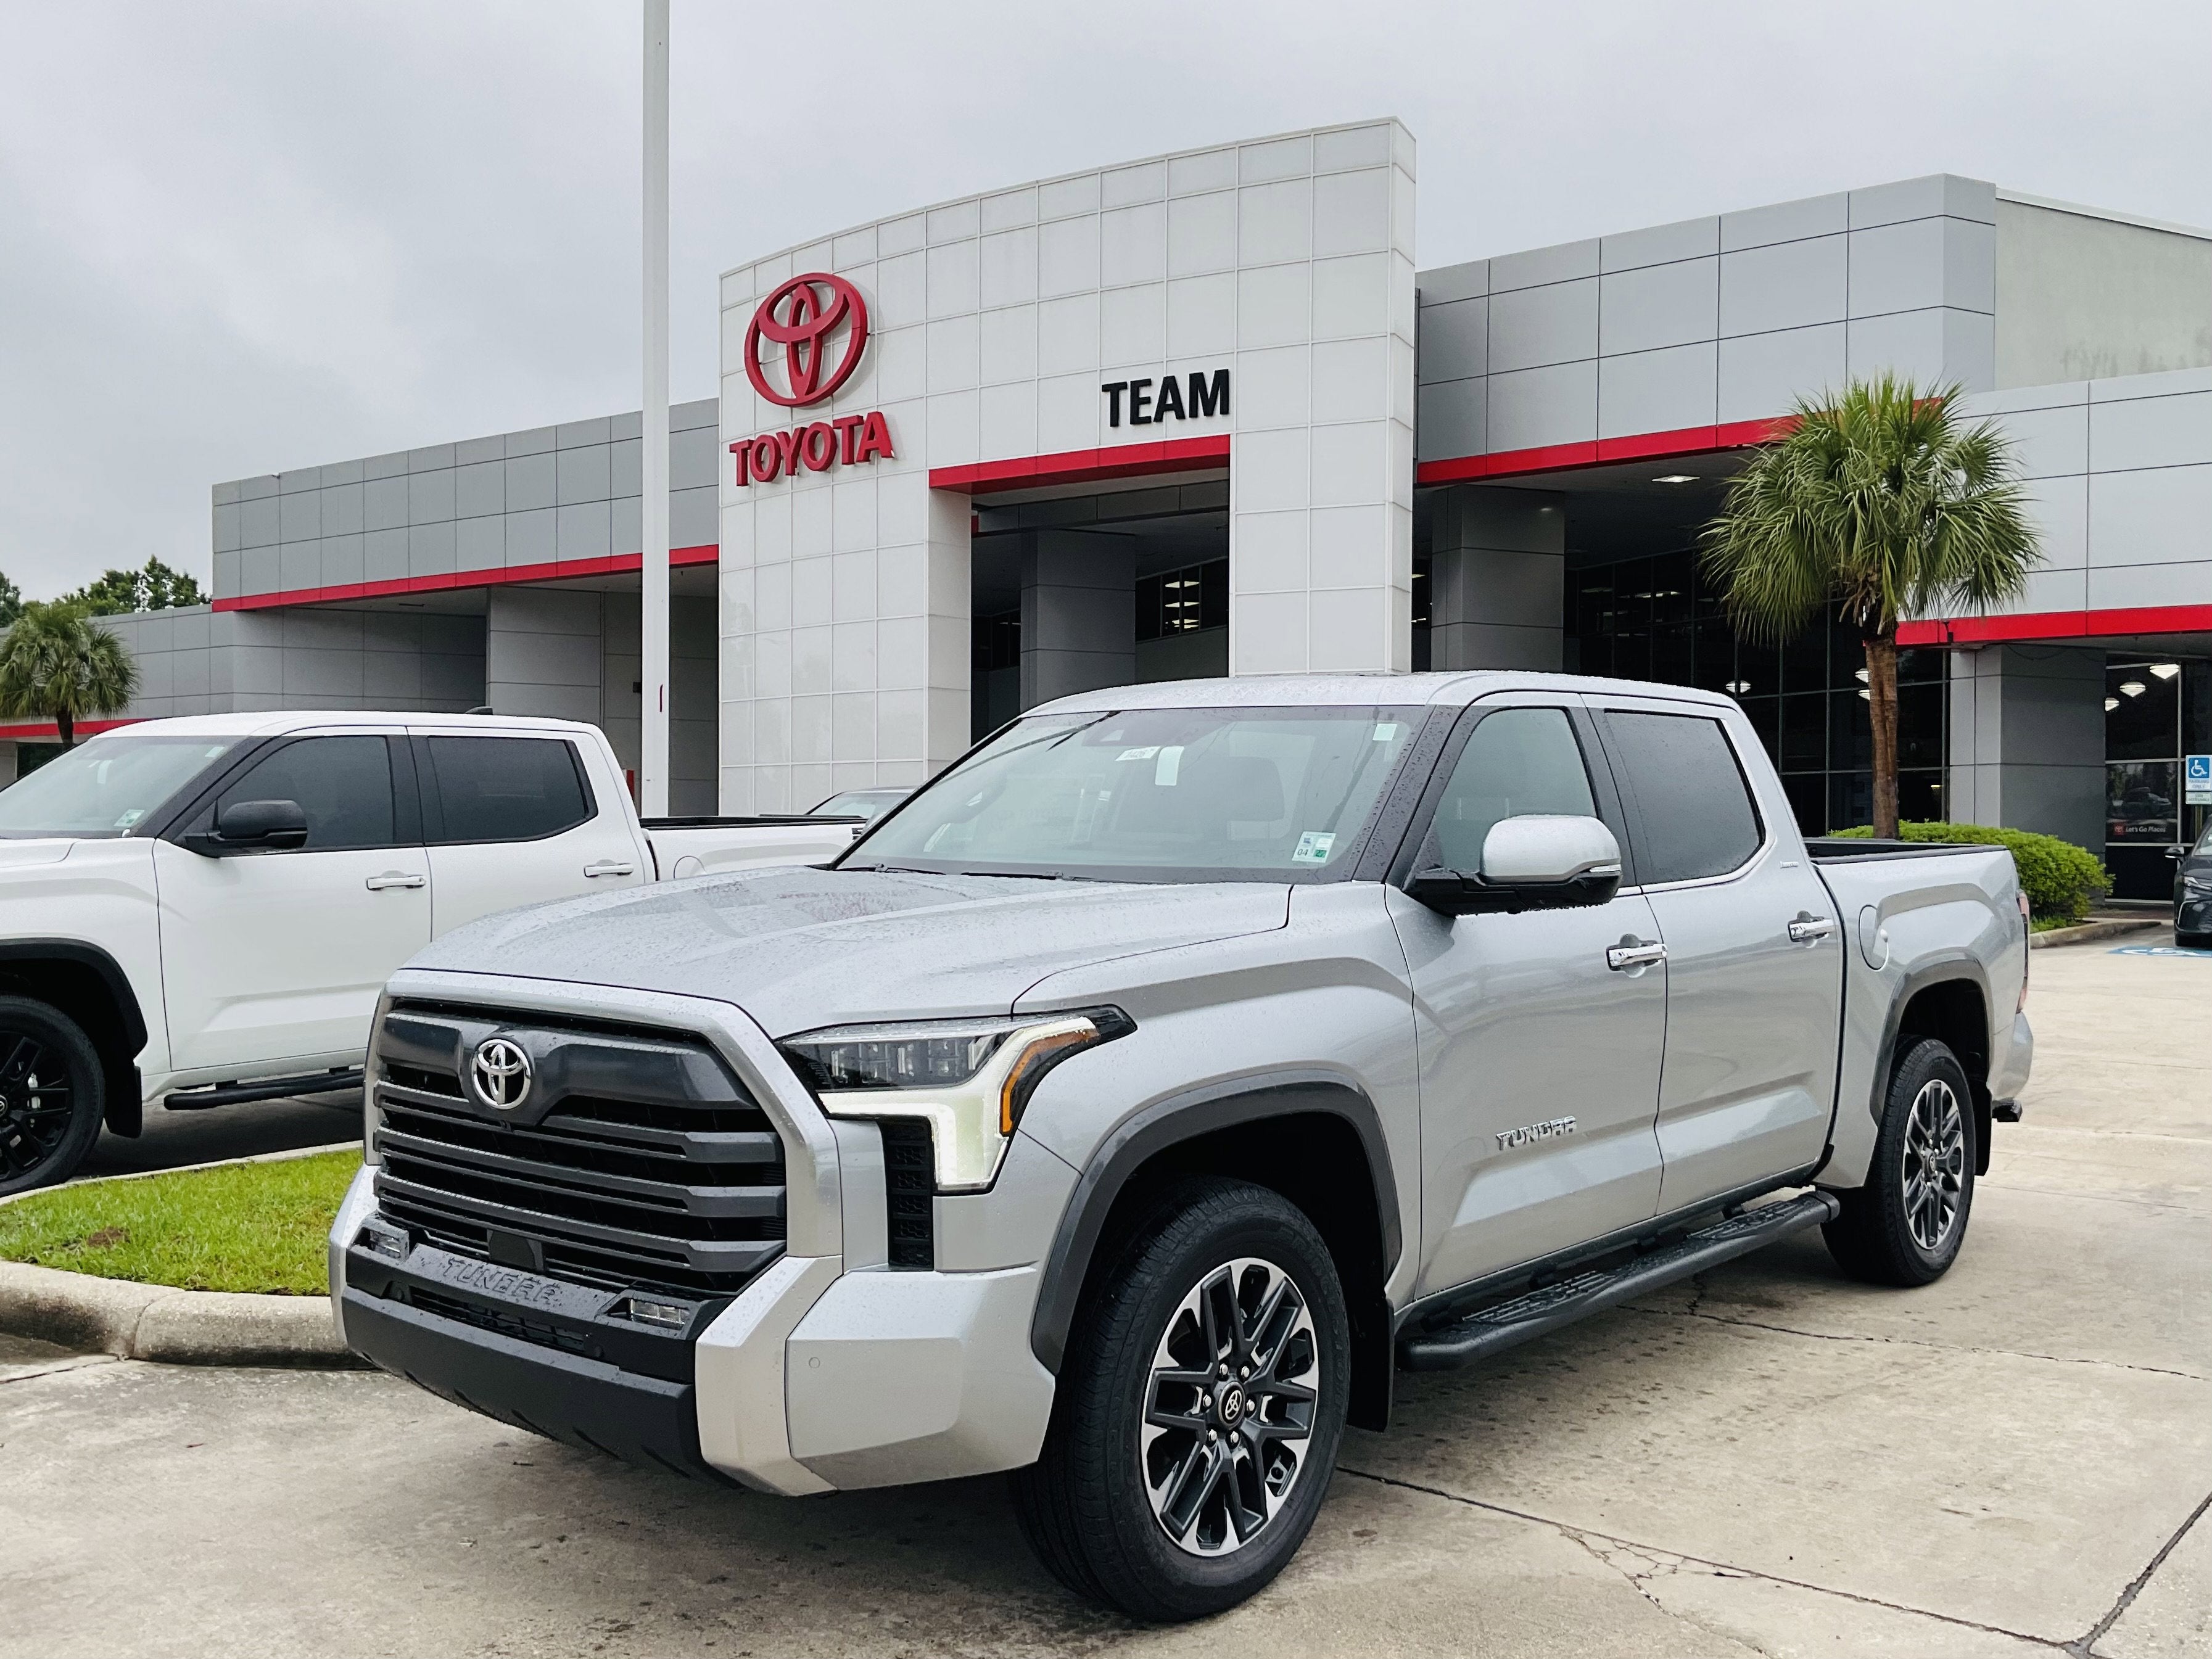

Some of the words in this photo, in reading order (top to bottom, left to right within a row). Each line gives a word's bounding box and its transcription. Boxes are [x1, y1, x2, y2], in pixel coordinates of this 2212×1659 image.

[1102, 369, 1229, 427] TEAM
[729, 411, 894, 486] TOYOTA
[1496, 1115, 1577, 1150] TUNDRA
[443, 1258, 560, 1306] TUNDRA
